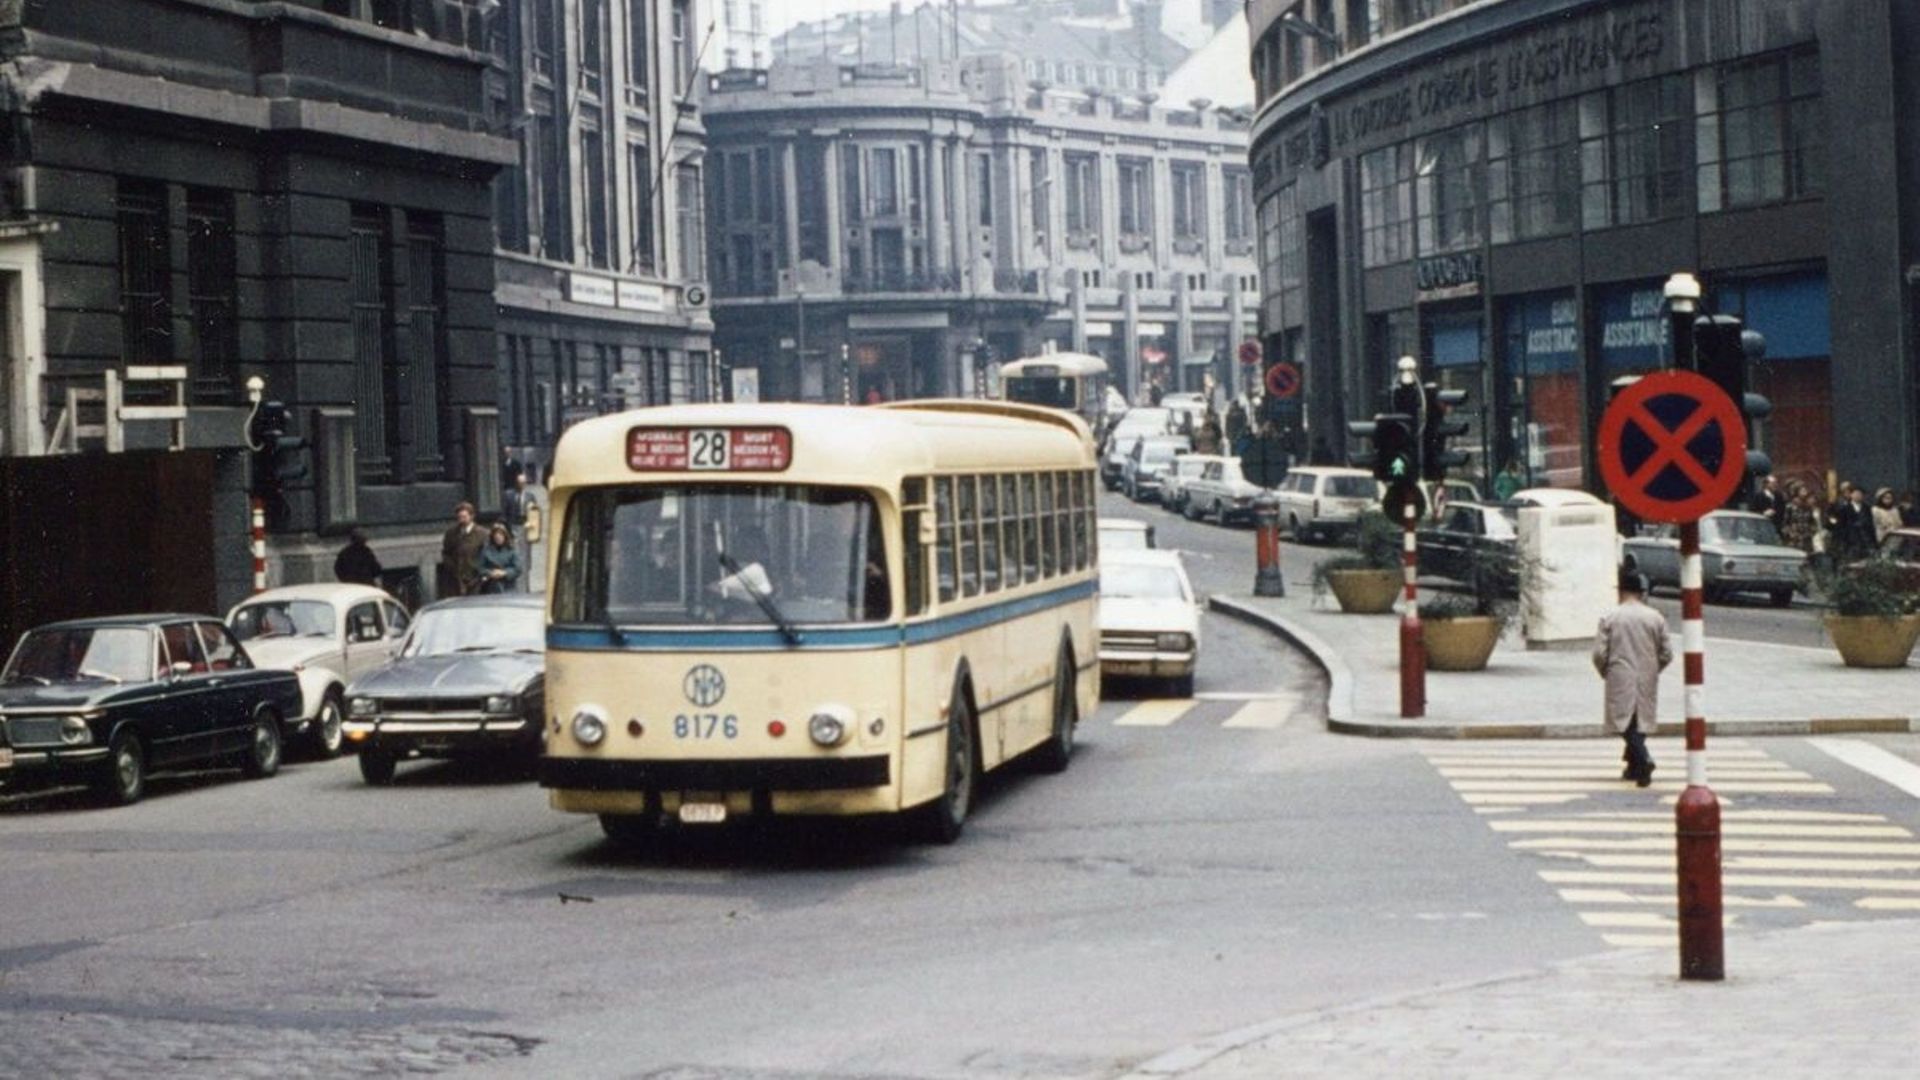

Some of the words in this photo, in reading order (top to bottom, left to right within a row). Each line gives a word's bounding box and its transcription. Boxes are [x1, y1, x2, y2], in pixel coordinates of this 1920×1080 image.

[1526, 327, 1578, 354] ASSISTANC
[1602, 318, 1670, 348] ASSISTANCE
[692, 432, 726, 466] 28
[674, 714, 738, 739] 8176
